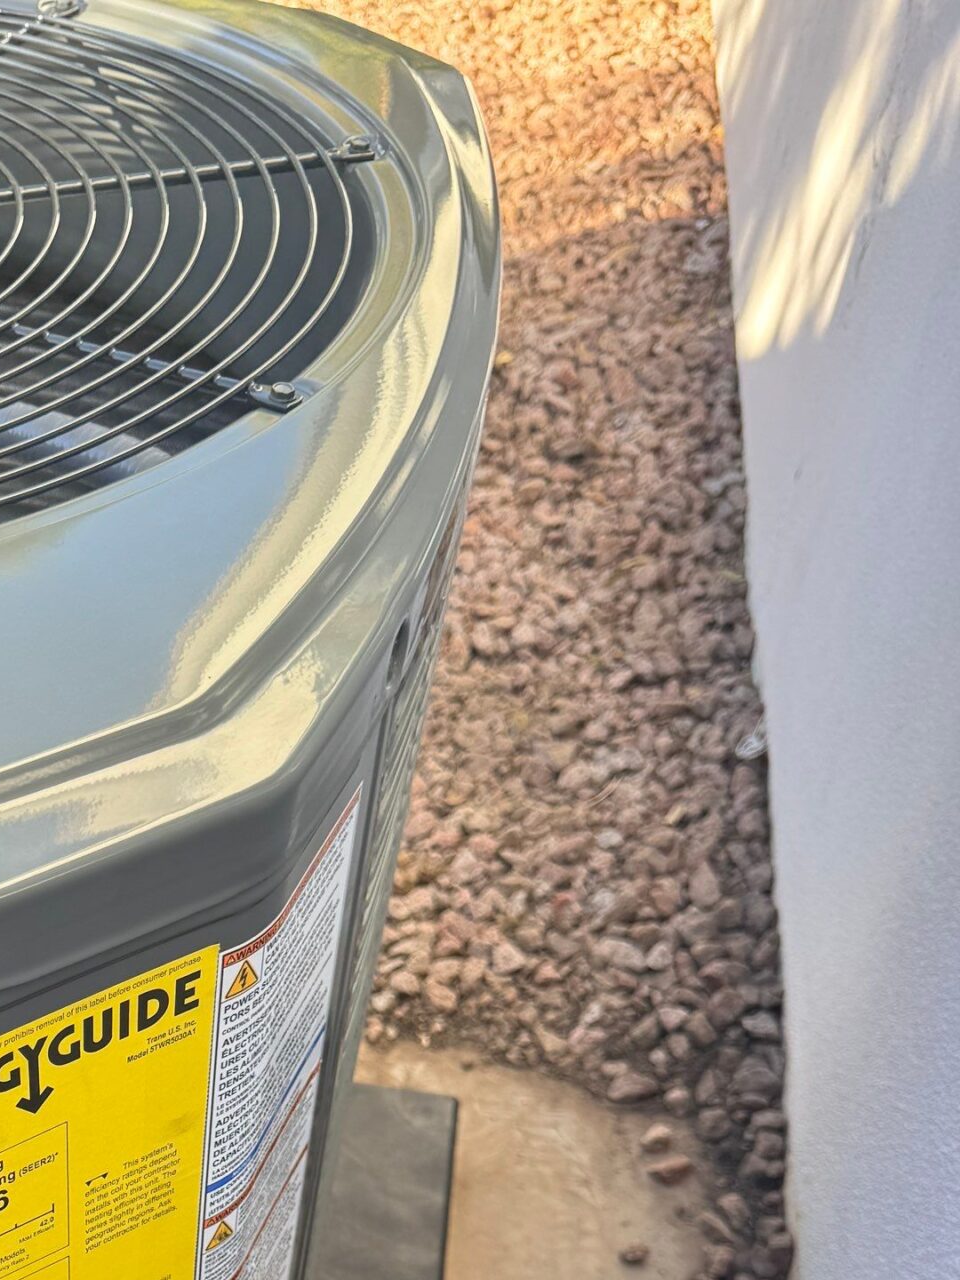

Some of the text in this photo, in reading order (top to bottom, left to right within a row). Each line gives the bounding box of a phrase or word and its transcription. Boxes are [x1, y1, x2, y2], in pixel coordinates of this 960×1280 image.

[4, 1028, 35, 1047] prohibits
[36, 1012, 65, 1031] removal
[66, 1008, 74, 1018] of
[75, 1003, 88, 1014] this
[89, 993, 107, 1007] label
[108, 985, 132, 1000] before
[132, 970, 168, 990] consumer
[224, 987, 260, 1014] POWER
[223, 1005, 251, 1026] TORS
[146, 1020, 197, 1045] Trane U.S. Inc.
[127, 1048, 149, 1063] Model
[220, 1048, 247, 1070] URES
[219, 1065, 239, 1081] LES
[123, 1142, 174, 1170] This system's
[213, 1145, 227, 1158] DE
[85, 1149, 178, 1198] efficiency ratings depend
[85, 1158, 181, 1207] on the coil your contractor
[85, 1200, 111, 1217] installs
[112, 1190, 128, 1204] with
[129, 1184, 143, 1195] this
[162, 1169, 177, 1180] The
[85, 1181, 172, 1226] heating efficiency rating
[85, 1187, 175, 1235] varies slightly in different
[85, 1221, 126, 1246] geographic
[157, 1199, 172, 1210] Ask
[85, 1240, 102, 1254] your
[103, 1222, 140, 1245] contractor
[141, 1217, 151, 1227] for
[0, 1247, 26, 1266] Models
